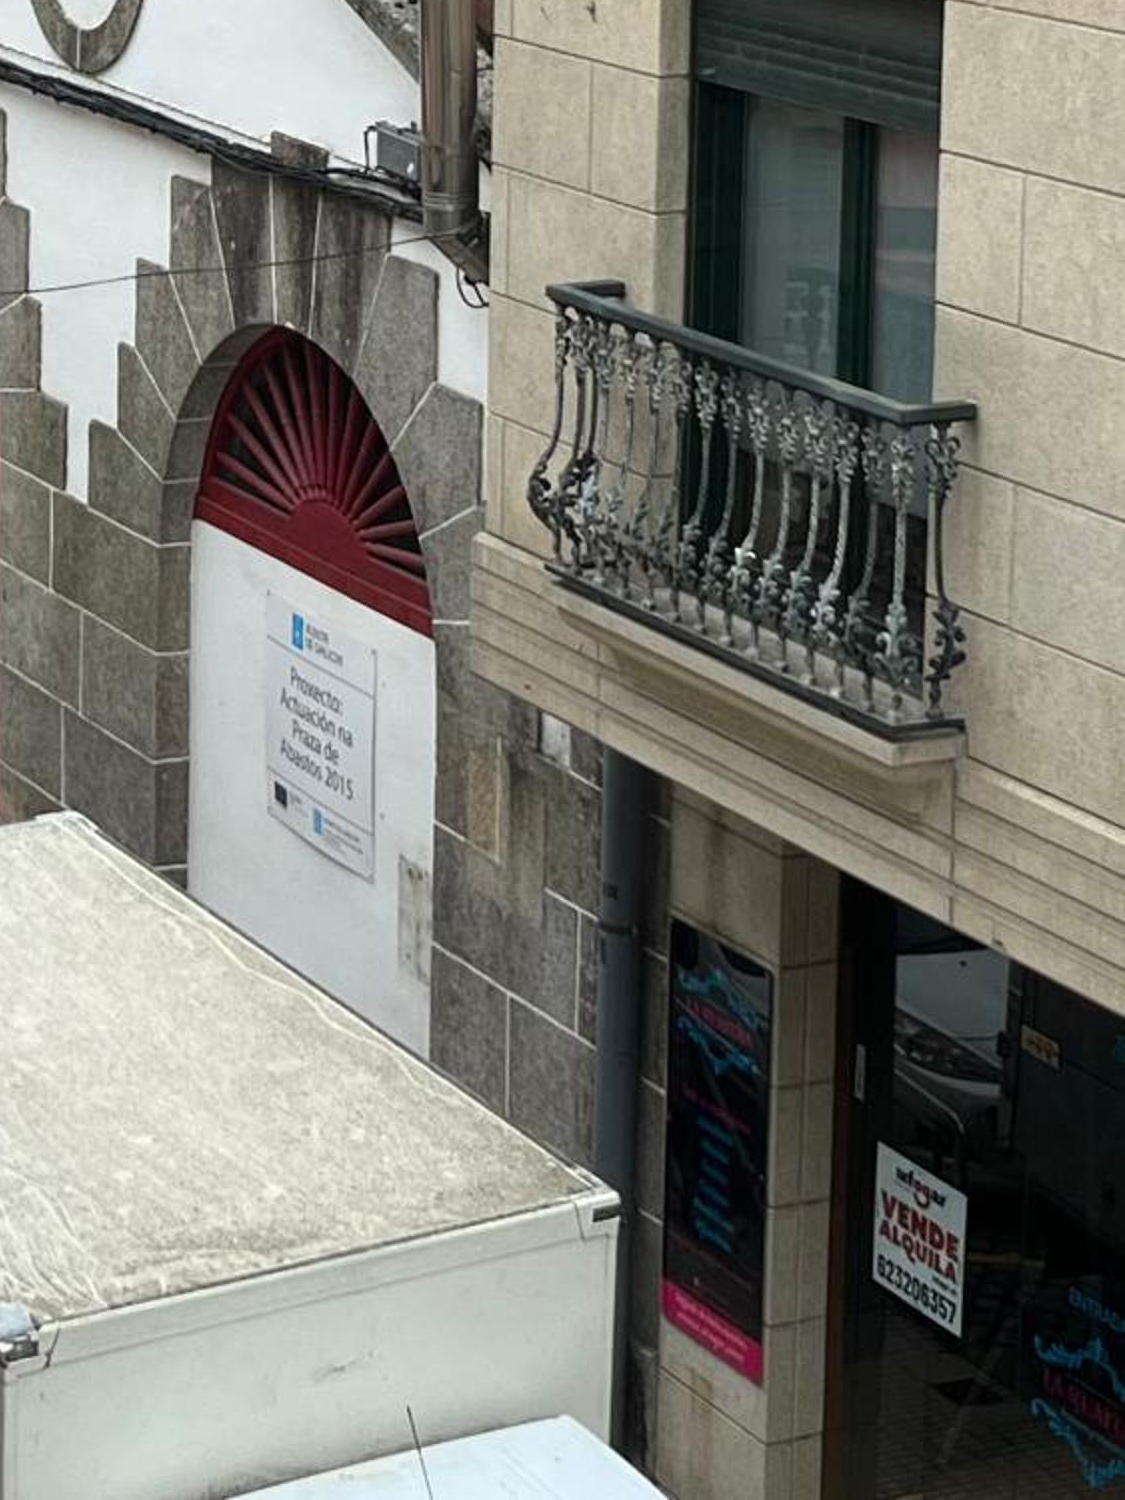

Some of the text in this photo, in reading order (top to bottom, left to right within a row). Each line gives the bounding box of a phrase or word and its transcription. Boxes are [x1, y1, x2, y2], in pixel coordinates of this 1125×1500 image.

[292, 718, 340, 766] Praza de
[338, 726, 353, 748] na
[324, 765, 354, 800] 2015
[879, 1219, 957, 1285] ALQUILA
[881, 1188, 959, 1262] VENDE
[877, 1252, 957, 1324] 623206357
